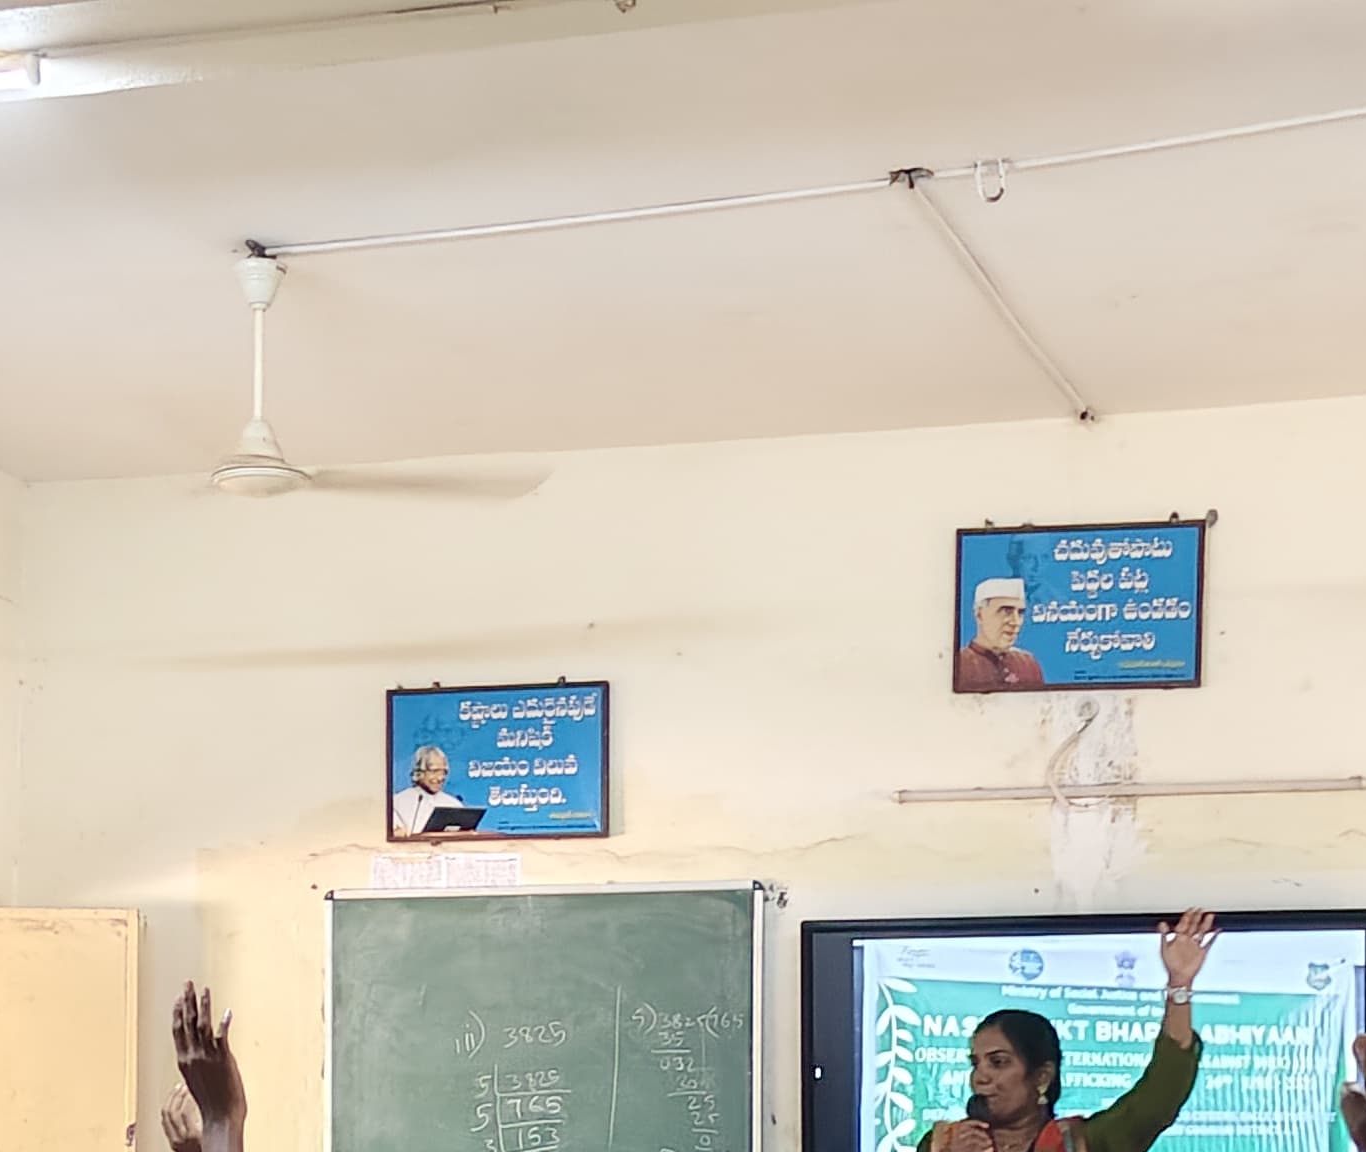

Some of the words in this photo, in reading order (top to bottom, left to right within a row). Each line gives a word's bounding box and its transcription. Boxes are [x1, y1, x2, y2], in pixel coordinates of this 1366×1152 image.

[1070, 569, 1115, 599] పెద్దల
[1118, 566, 1150, 594] పట్ల
[1031, 600, 1118, 623] వినయంగా
[1123, 597, 1193, 620] ఉండడం
[1065, 627, 1156, 660] నేర్చుకోవాలి
[459, 700, 508, 728] కష్టాలు
[468, 757, 529, 778] విజయం
[533, 754, 578, 775] విలువ
[502, 1020, 567, 1048] 3825
[923, 1014, 980, 1036] NAS
[470, 1102, 493, 1132] 5
[506, 1095, 563, 1119] 765
[518, 1126, 561, 1150] 153
